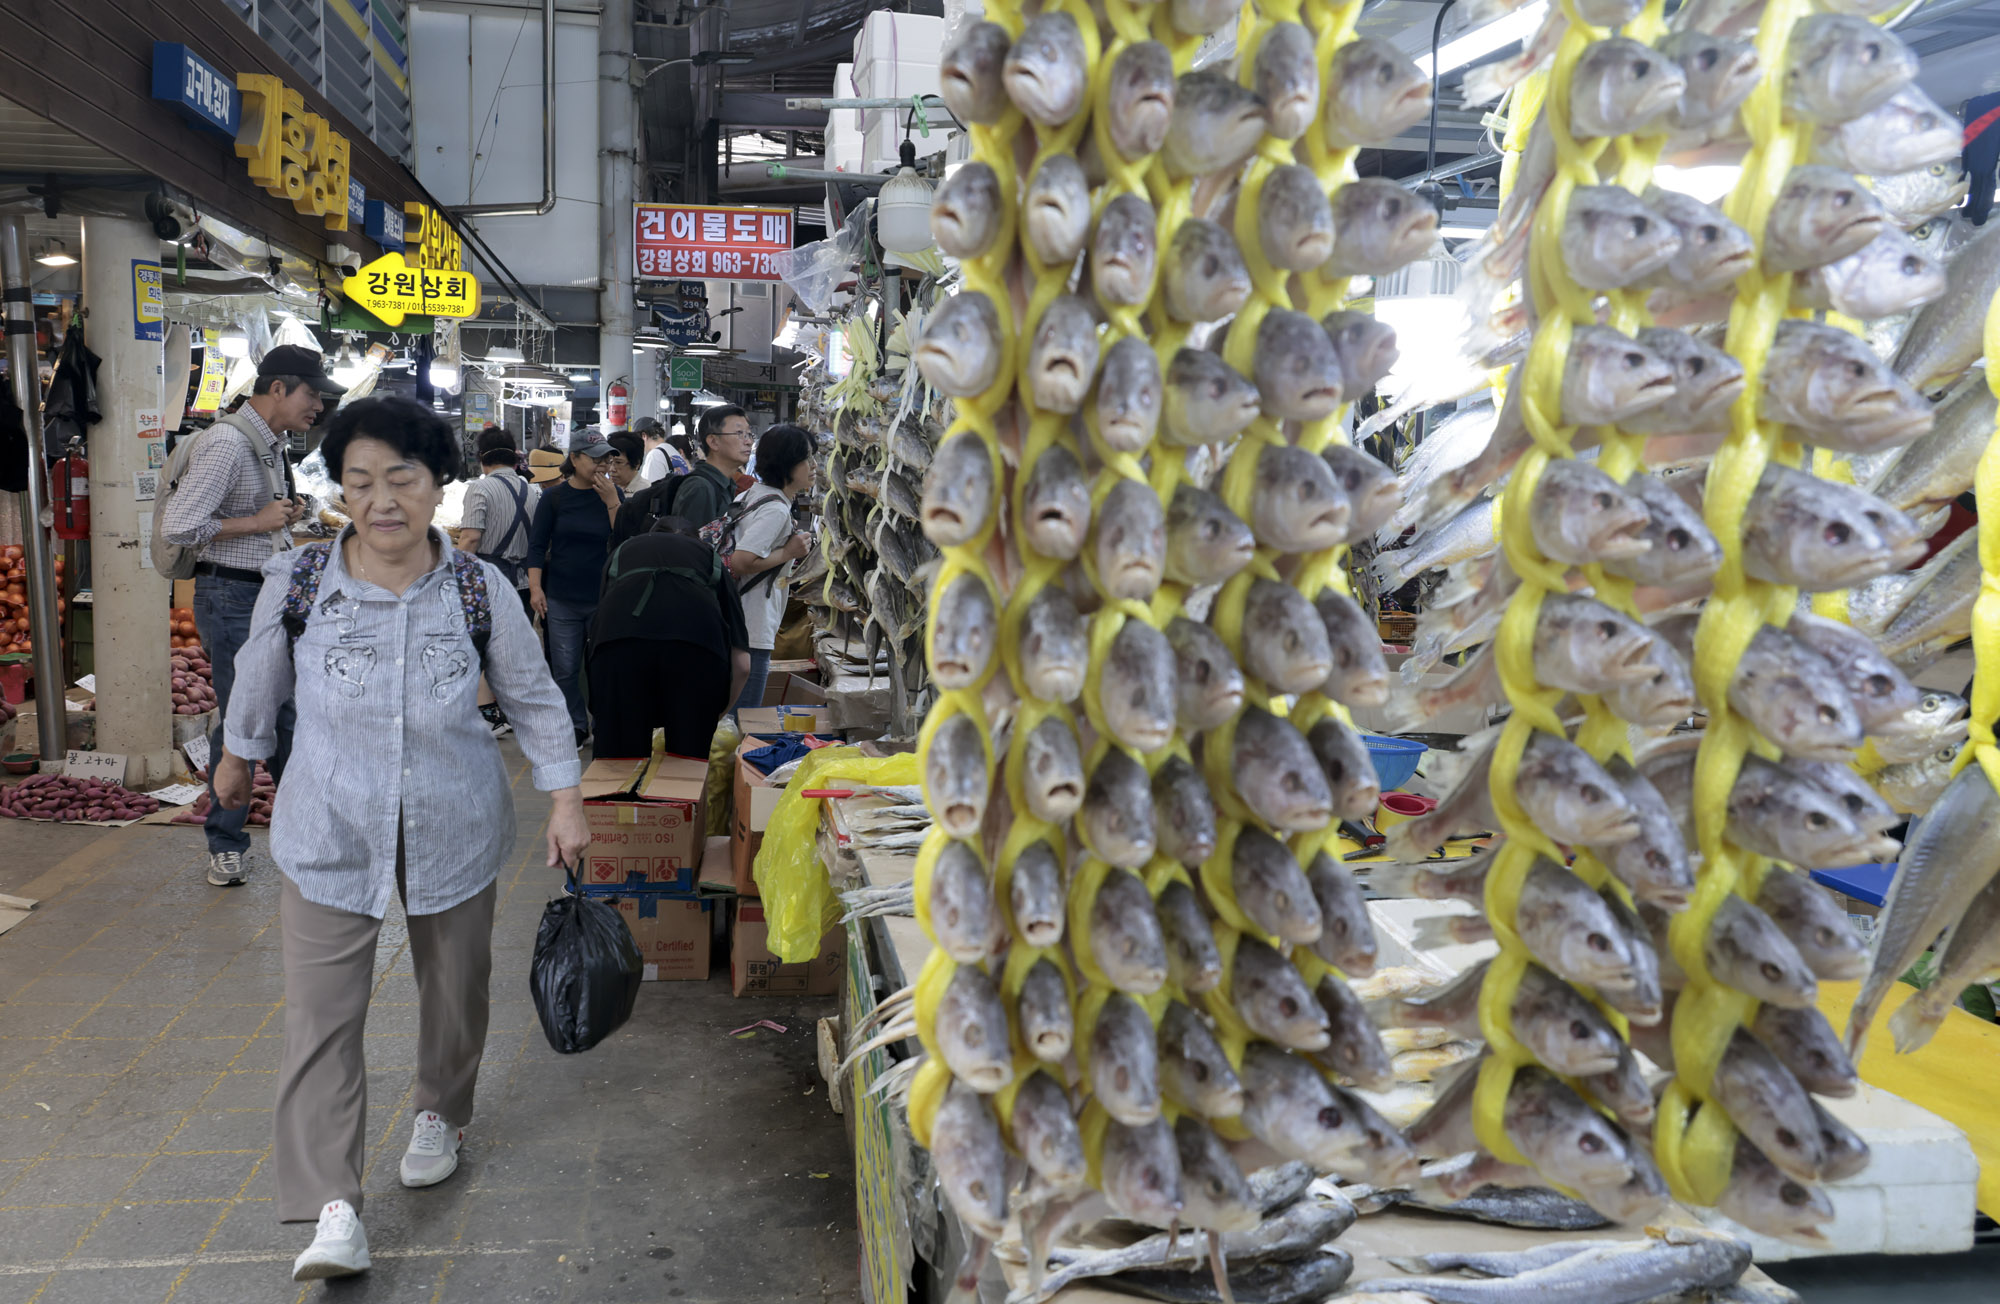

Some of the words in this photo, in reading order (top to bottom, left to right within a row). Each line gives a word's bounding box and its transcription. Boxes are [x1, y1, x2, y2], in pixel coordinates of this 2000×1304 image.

[640, 211, 787, 244] 건어물도매
[640, 249, 706, 273] 강원상회
[712, 251, 779, 275] 963-738
[368, 272, 467, 301] 강원상회
[366, 299, 406, 311] T.963-7381
[411, 302, 465, 313] 010-5539-7381
[591, 833, 629, 844] Certified
[655, 833, 674, 844] ISO
[656, 940, 694, 952] Certified
[749, 963, 767, 976] 품명
